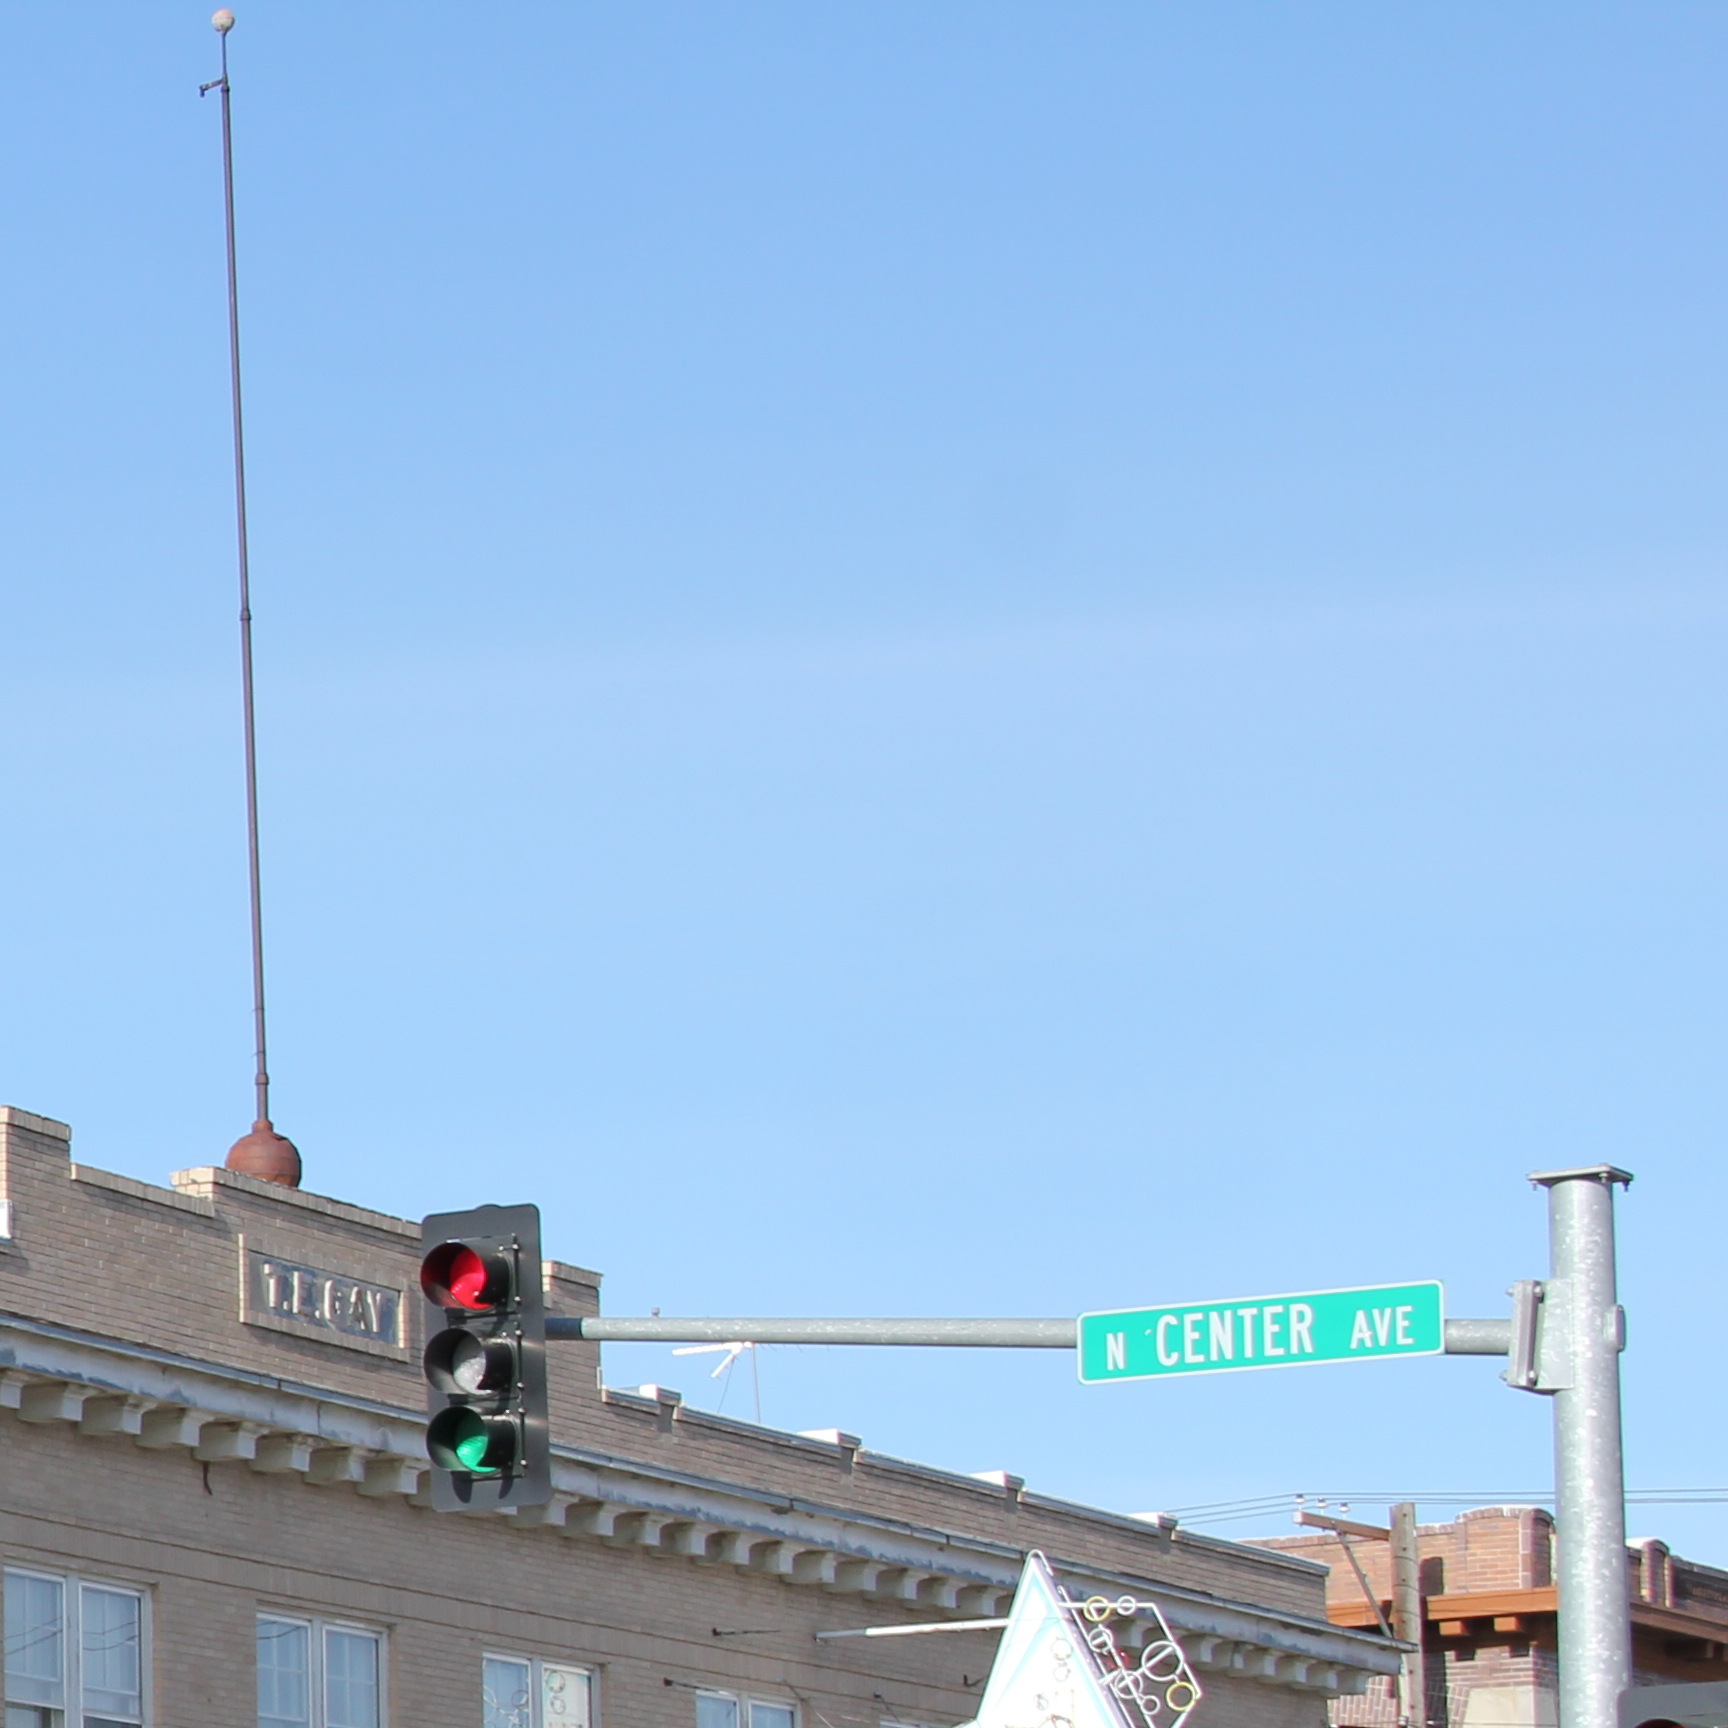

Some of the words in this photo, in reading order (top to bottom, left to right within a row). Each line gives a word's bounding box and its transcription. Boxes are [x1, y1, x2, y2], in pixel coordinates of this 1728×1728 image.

[1106, 1332, 1125, 1371] N
[1155, 1303, 1315, 1367] CENTER
[1350, 1305, 1414, 1350] AVE
